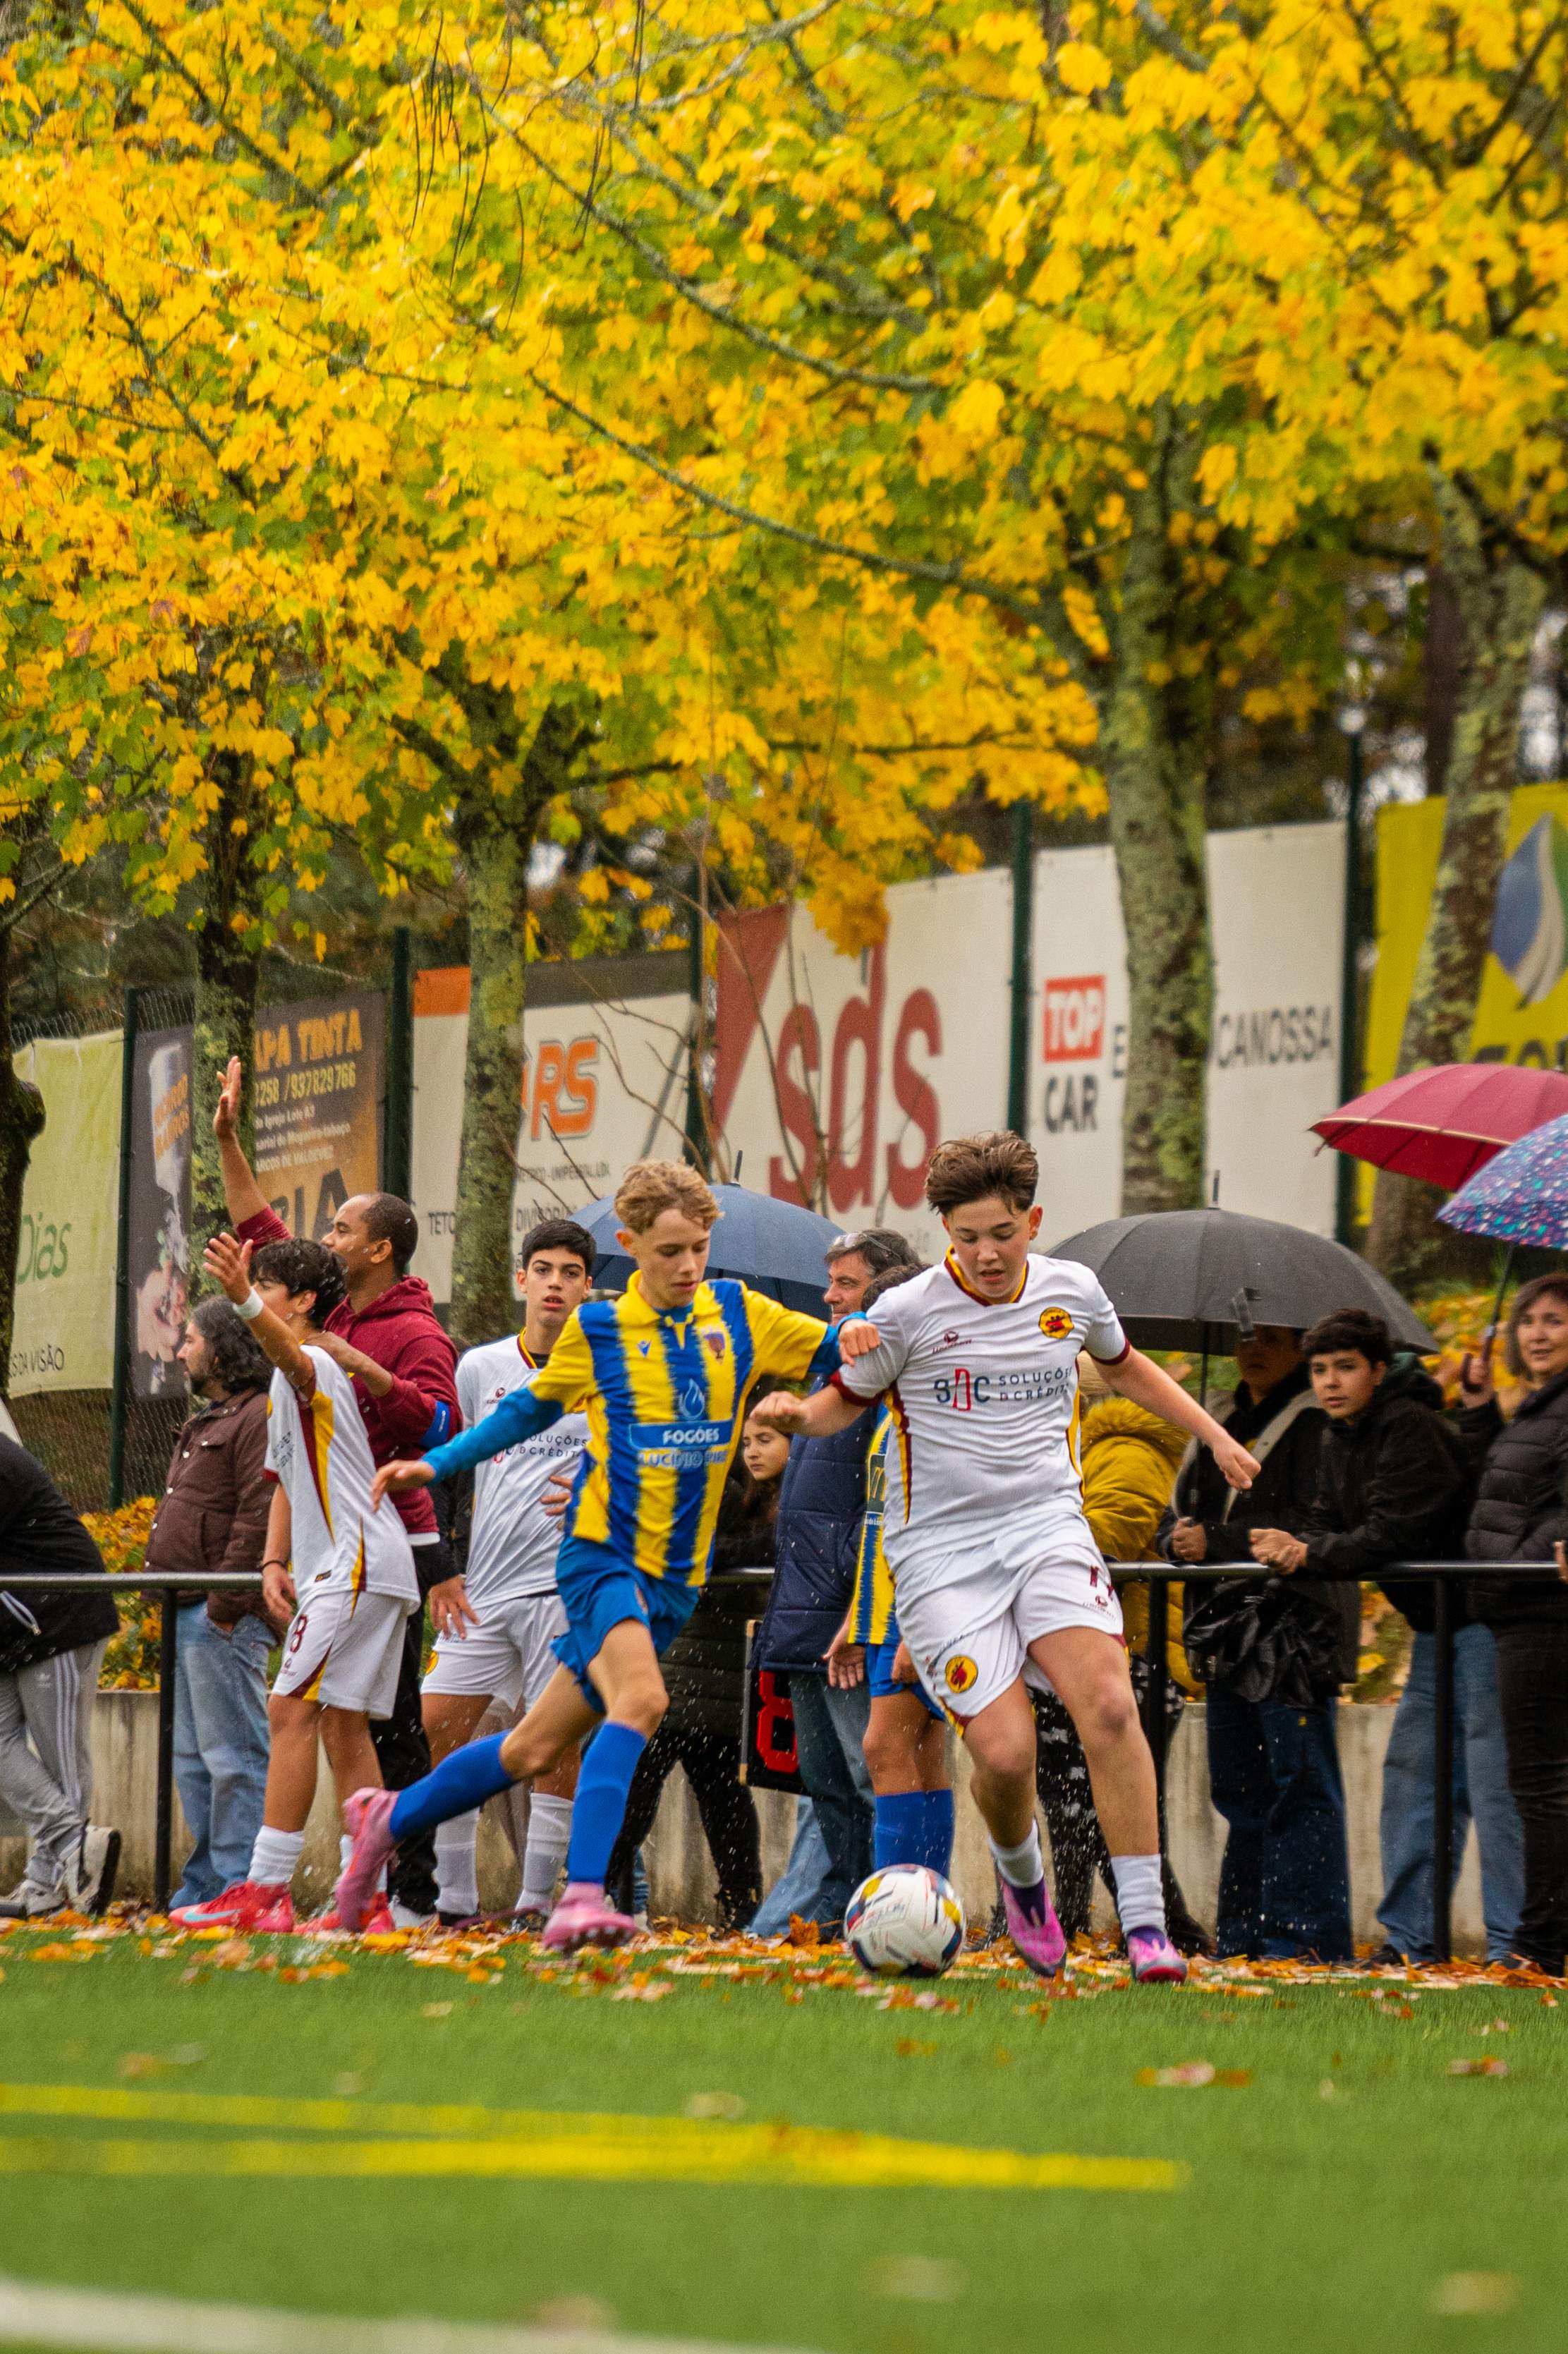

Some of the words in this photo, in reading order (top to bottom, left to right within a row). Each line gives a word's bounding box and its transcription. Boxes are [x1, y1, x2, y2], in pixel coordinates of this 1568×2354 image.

[1049, 989, 1101, 1052] TOP
[1217, 1006, 1332, 1069] CANOSSA
[1045, 1074, 1098, 1133] CAR
